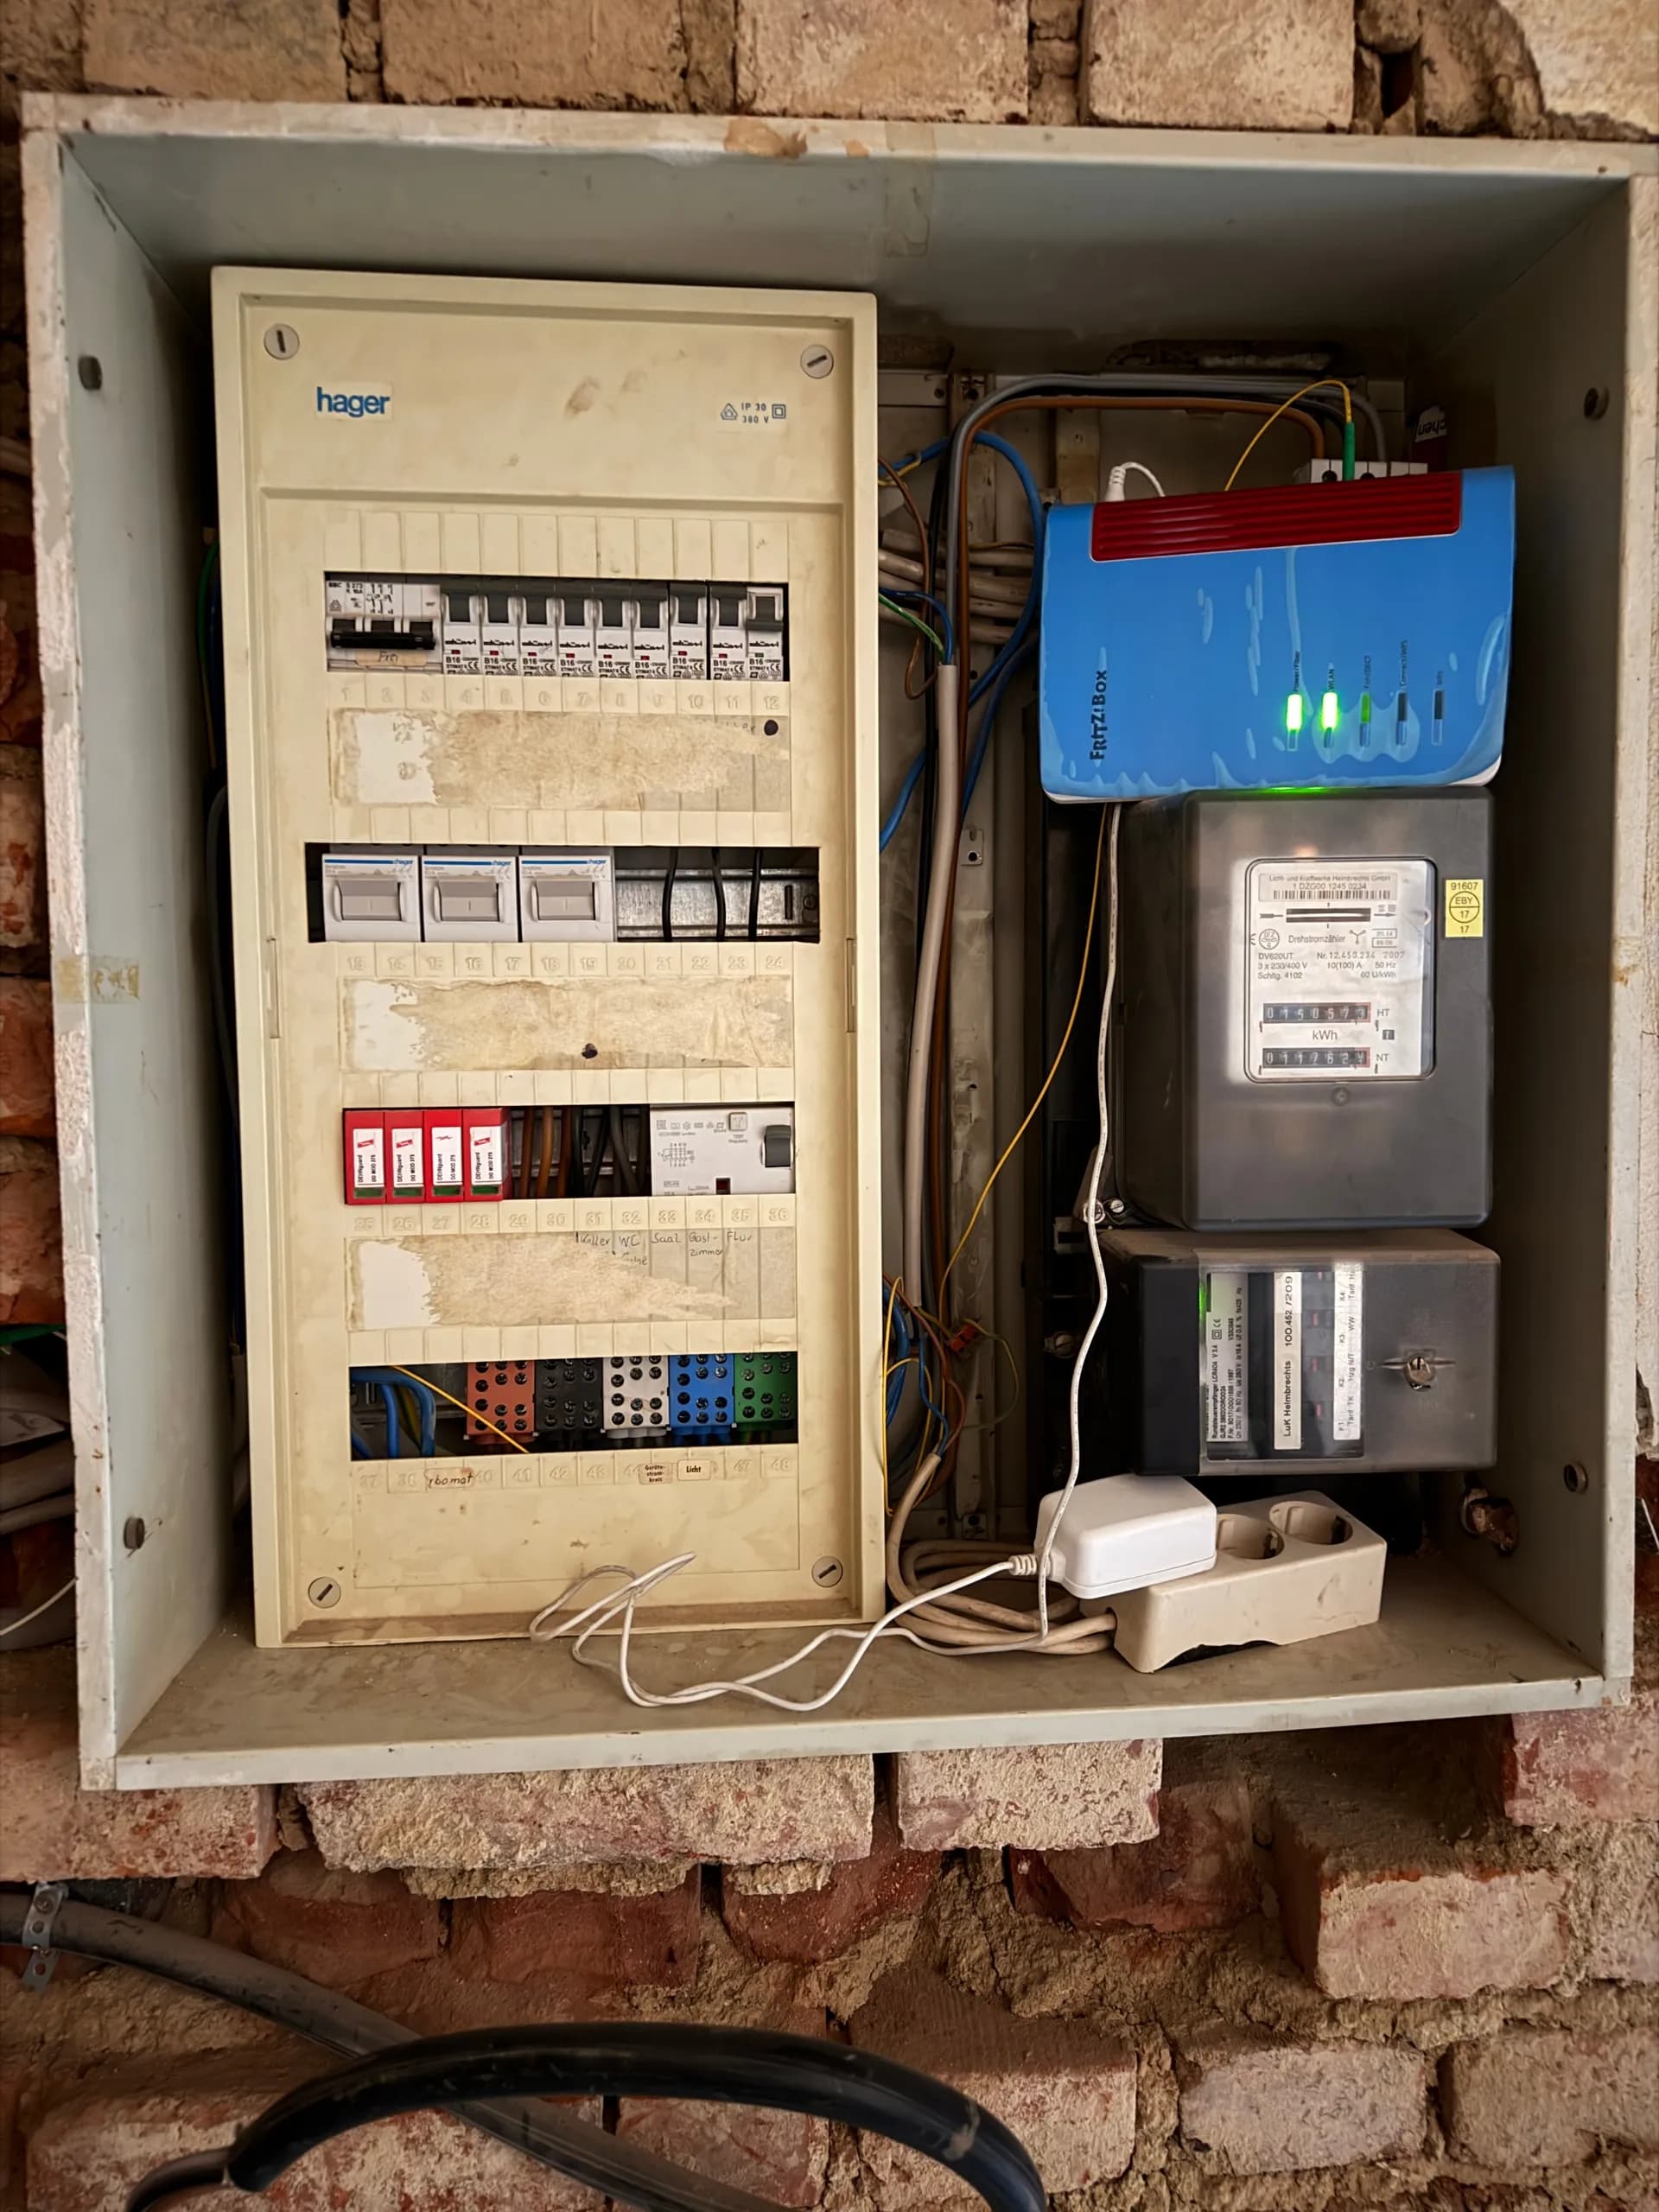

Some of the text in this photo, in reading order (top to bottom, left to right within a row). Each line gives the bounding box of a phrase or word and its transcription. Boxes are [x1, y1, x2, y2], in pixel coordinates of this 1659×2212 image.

[316, 386, 391, 418] hager
[741, 403, 766, 411] IP 30
[742, 415, 759, 423] 380
[1451, 881, 1478, 891] 91607
[1455, 896, 1473, 905] EBY
[1460, 910, 1470, 918] 17
[1460, 925, 1470, 933] 17
[1288, 934, 1346, 944] Drehstromzähler
[1316, 951, 1327, 960] Nr.
[1327, 962, 1355, 970] 10(100)
[1376, 1008, 1390, 1017] HT
[1312, 1029, 1338, 1040] kWh
[1376, 1053, 1389, 1062] NT
[650, 1232, 682, 1243] Saal
[1283, 1361, 1292, 1416] Helmbrechts
[1283, 1419, 1292, 1437] LuK
